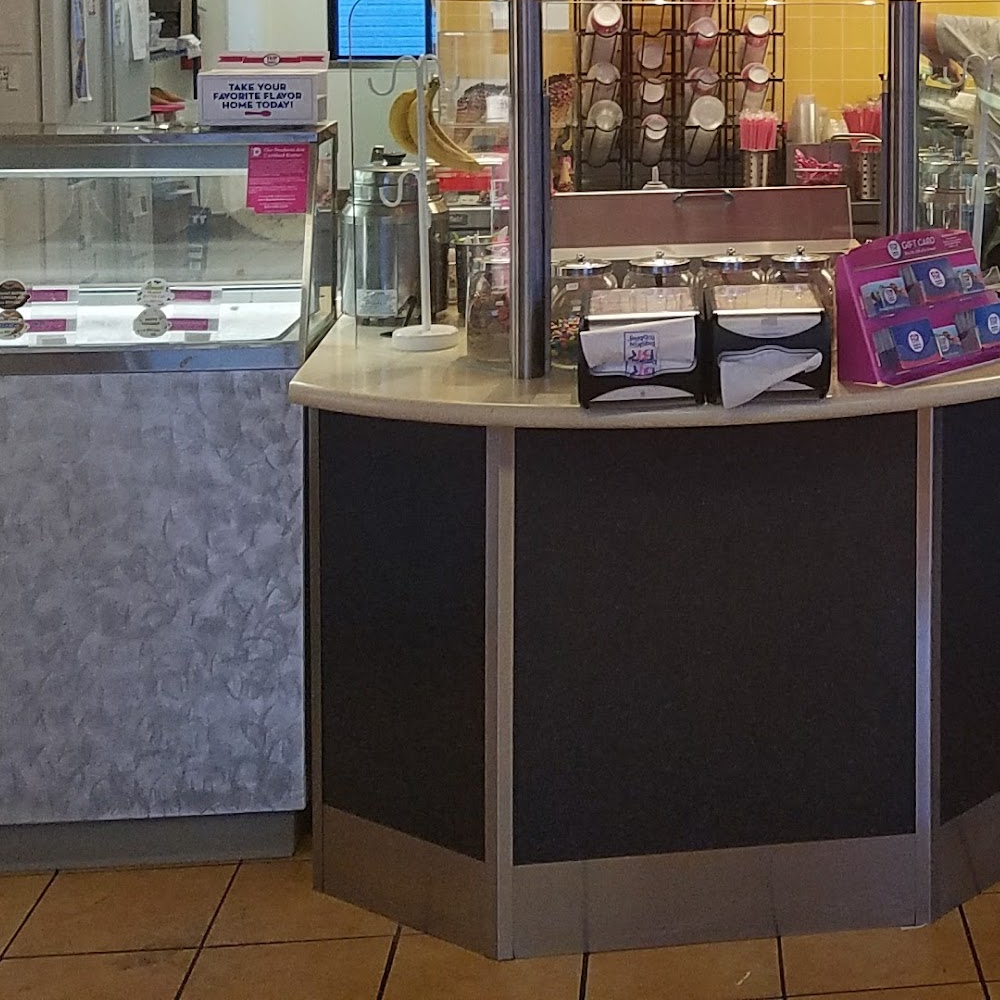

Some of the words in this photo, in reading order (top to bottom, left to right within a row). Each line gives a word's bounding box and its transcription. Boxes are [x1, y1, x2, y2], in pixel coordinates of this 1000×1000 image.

[229, 83, 254, 91] TAKE
[257, 83, 287, 91] YOUR
[213, 92, 261, 100] FAVORITE
[264, 92, 302, 100] FLAVOR
[222, 101, 253, 109] HOME
[257, 101, 294, 109] TODAY!
[901, 239, 917, 250] GIFT
[917, 236, 936, 247] CARD
